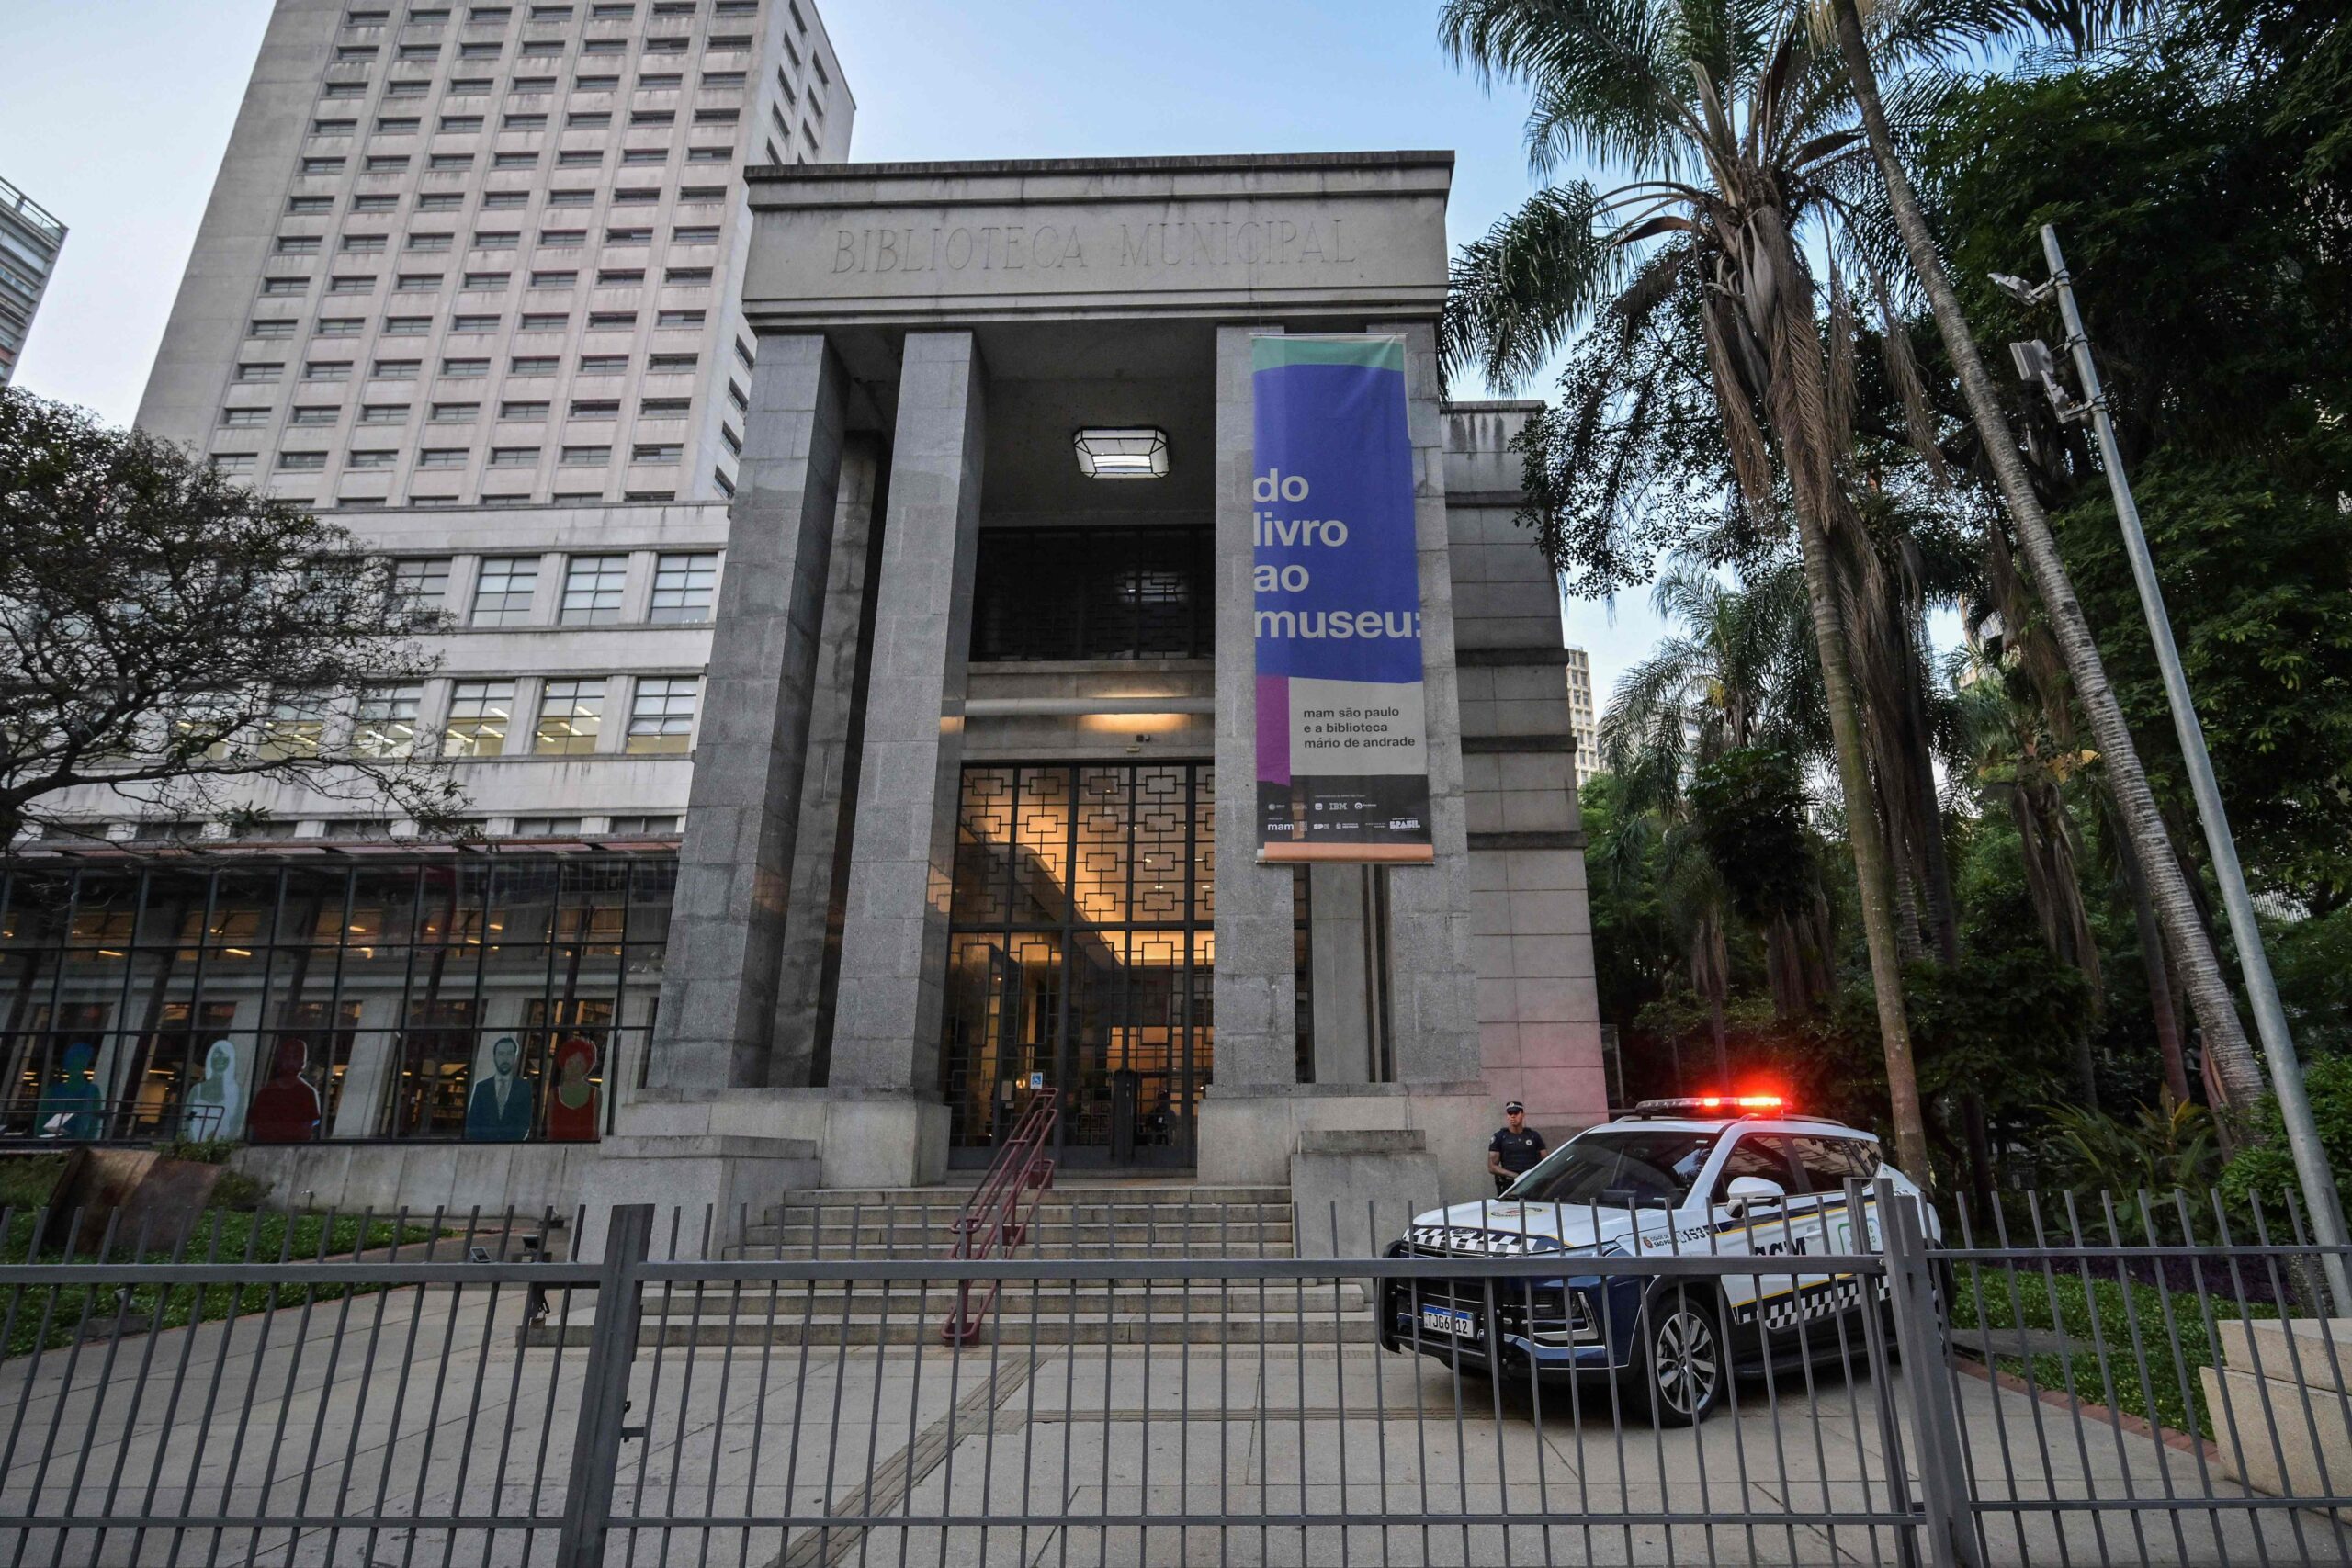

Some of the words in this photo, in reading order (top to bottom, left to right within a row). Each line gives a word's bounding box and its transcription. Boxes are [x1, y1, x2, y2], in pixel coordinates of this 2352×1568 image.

[831, 226, 1088, 273] BIBLIOTECA
[1119, 220, 1356, 266] MUNICIPAL
[1253, 468, 1309, 502] do
[1253, 512, 1349, 547] livro
[1254, 565, 1310, 592] ao
[1255, 611, 1421, 638] museu:
[1304, 710, 1335, 718] mam
[1339, 707, 1361, 717] são
[1364, 706, 1399, 719] paulo
[1304, 725, 1311, 733] e
[1315, 725, 1322, 733] a
[1327, 723, 1388, 733] biblioteca
[1305, 737, 1340, 748] mário
[1344, 738, 1360, 748] de
[1363, 737, 1415, 747] andrade
[1268, 823, 1294, 831] mam
[1390, 820, 1420, 829] BRASIL
[1427, 1314, 1468, 1334] TJG612
